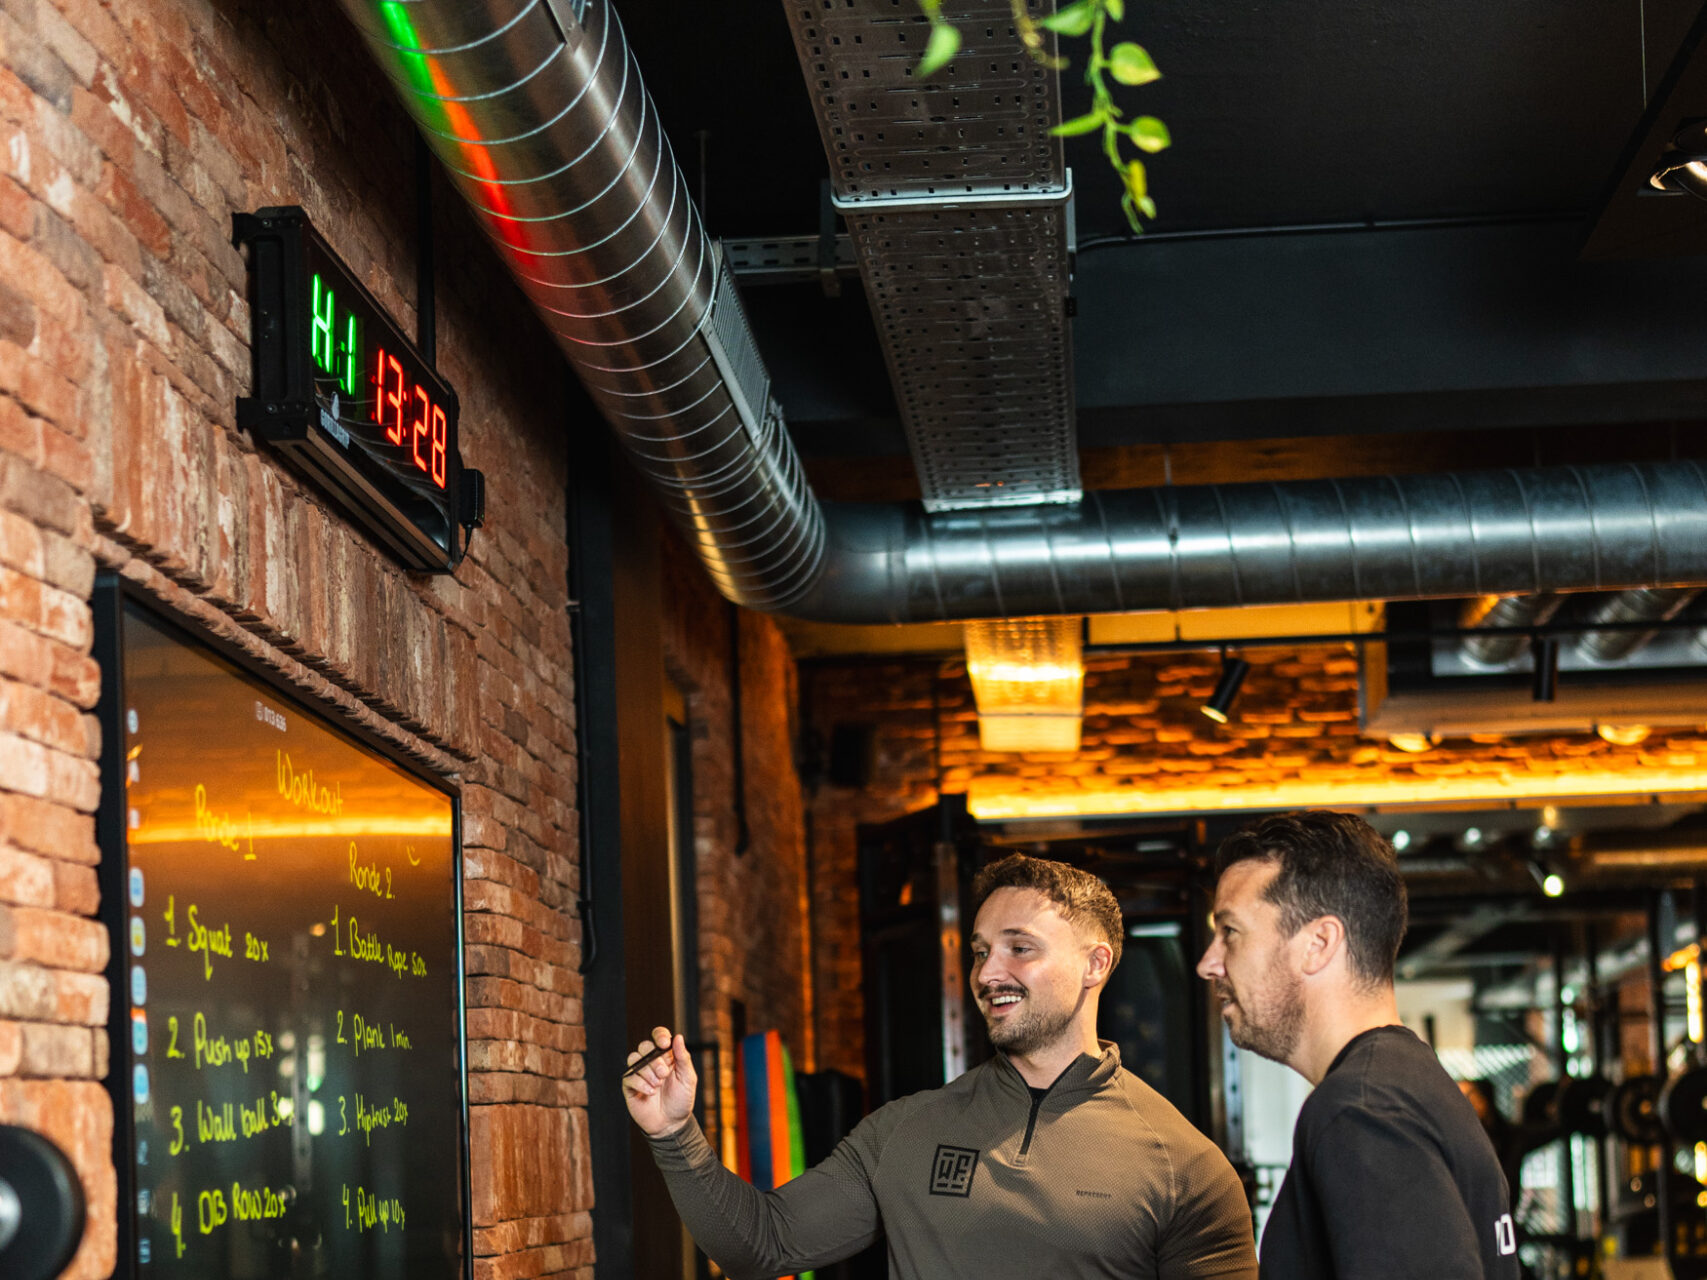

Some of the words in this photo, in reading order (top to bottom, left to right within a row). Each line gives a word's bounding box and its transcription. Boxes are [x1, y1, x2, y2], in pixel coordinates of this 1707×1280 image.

[349, 840, 382, 897] Ronde
[187, 904, 233, 981] Squat
[349, 916, 384, 964] Battle
[194, 1011, 232, 1070] Push
[235, 1038, 250, 1074] up
[169, 1105, 190, 1156] 3.
[198, 1099, 237, 1143] Wall
[240, 1097, 269, 1139] ball
[338, 1095, 350, 1136] 3.
[357, 1186, 377, 1233] Pull
